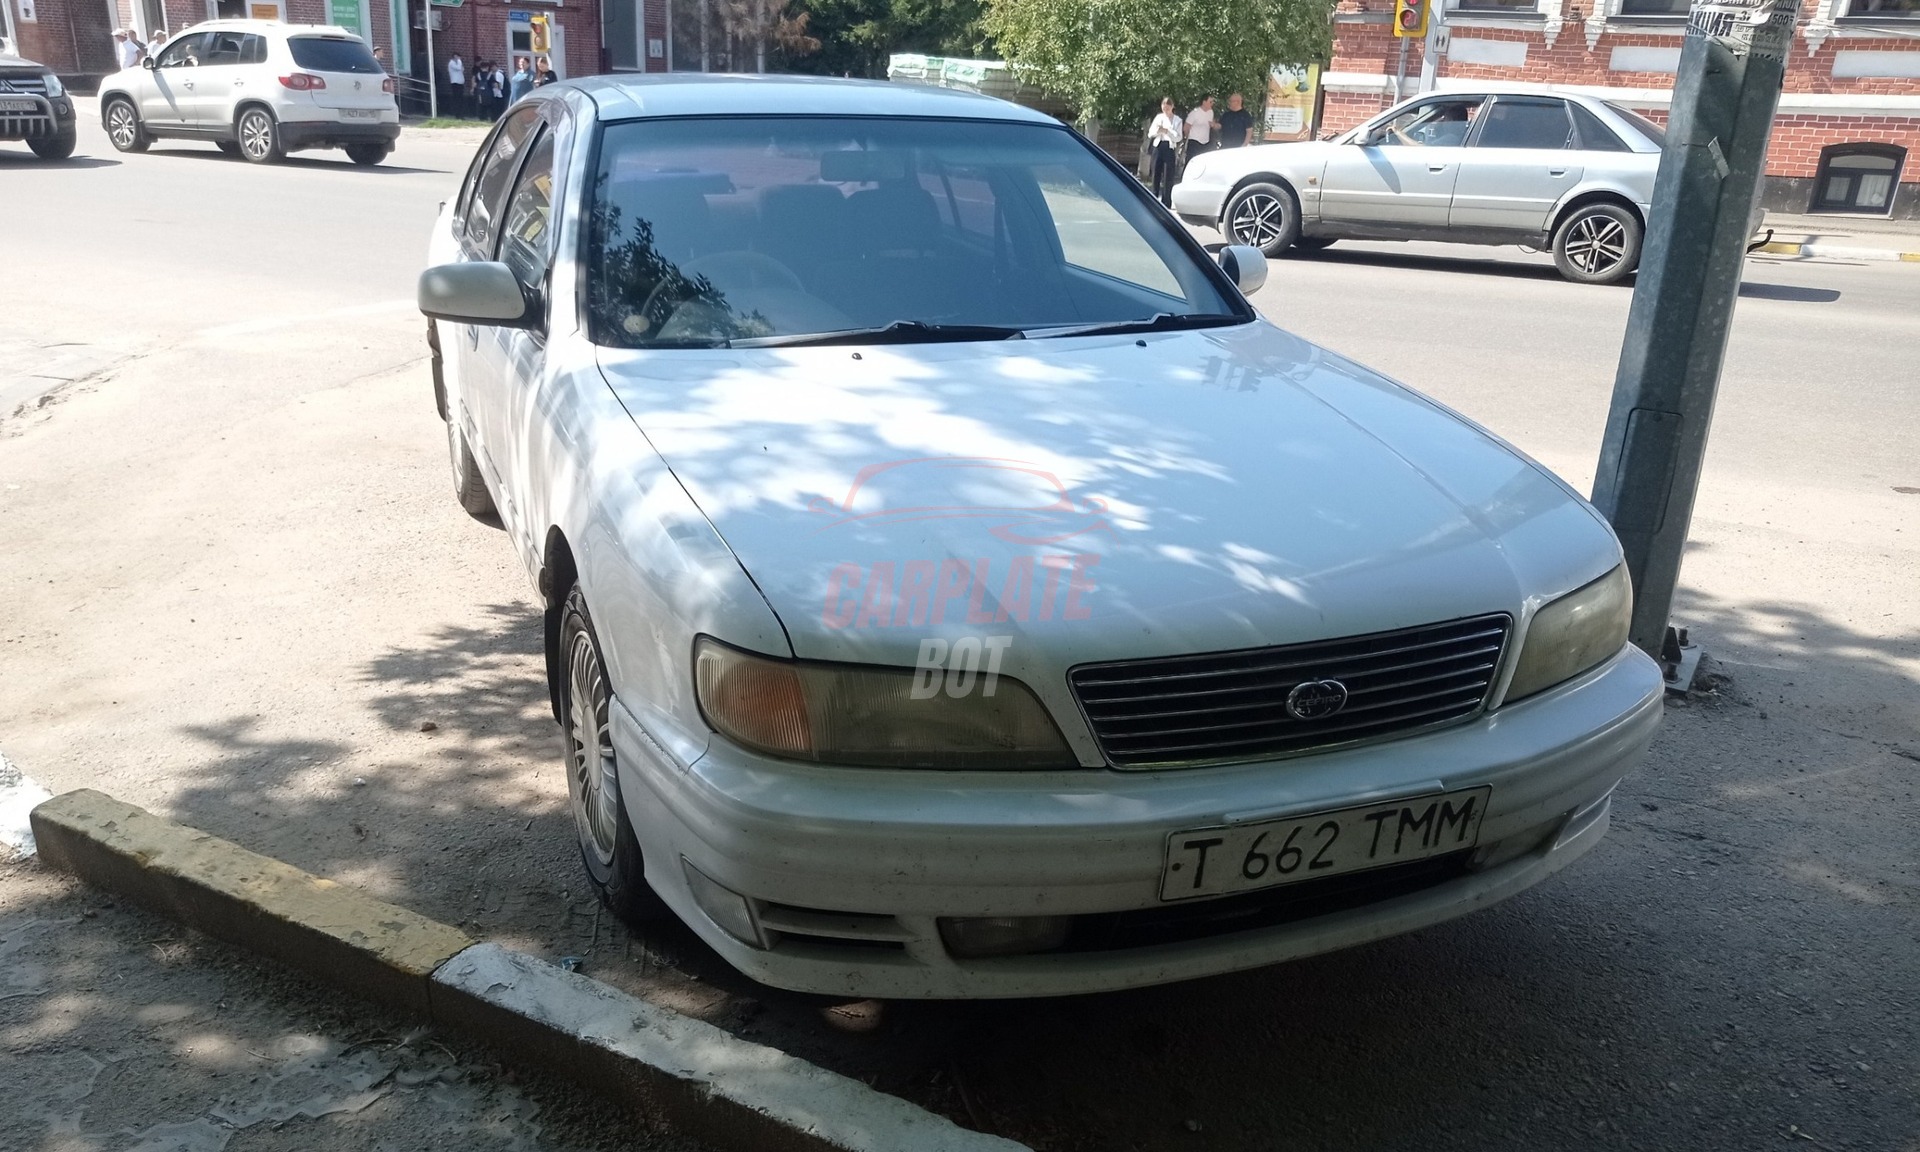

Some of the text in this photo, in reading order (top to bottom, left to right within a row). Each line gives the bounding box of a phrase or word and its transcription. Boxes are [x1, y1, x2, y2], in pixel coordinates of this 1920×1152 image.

[1296, 694, 1342, 707] CEFIRO
[1184, 795, 1476, 889] T 662 TMM
